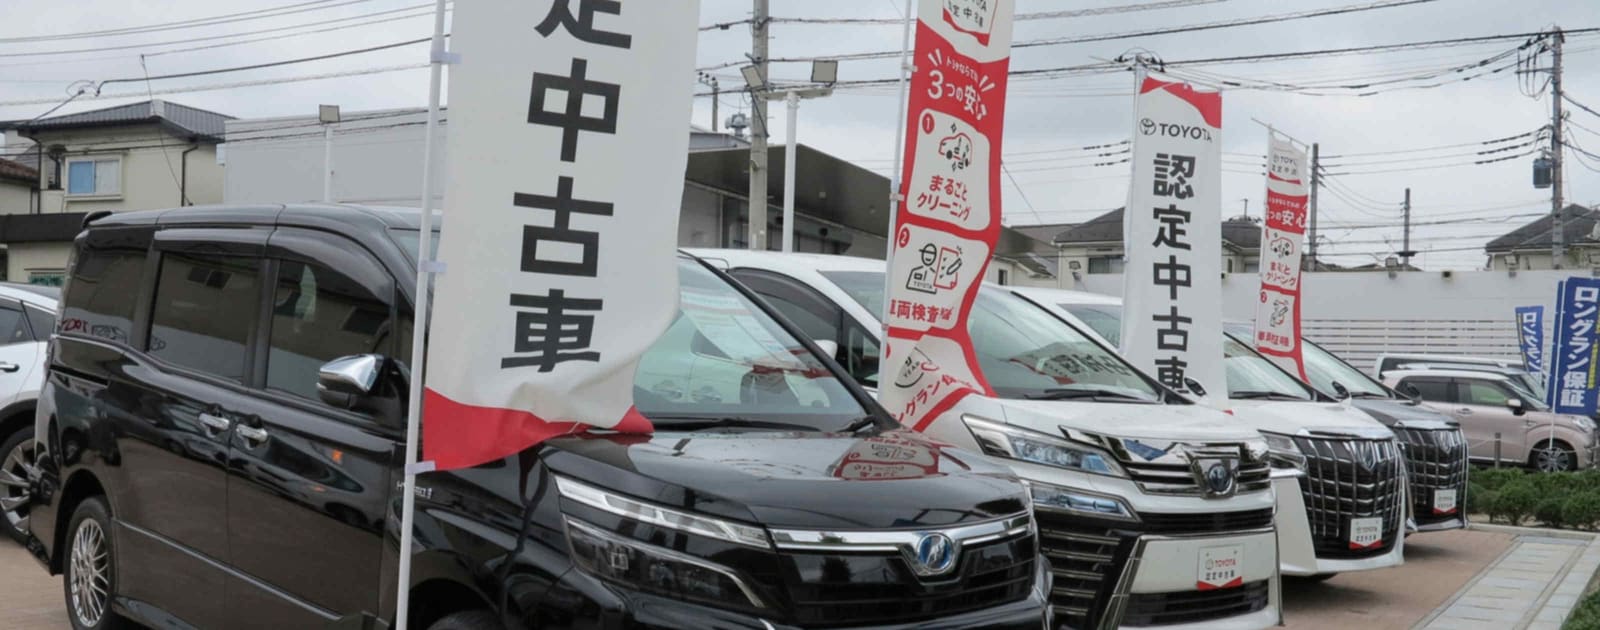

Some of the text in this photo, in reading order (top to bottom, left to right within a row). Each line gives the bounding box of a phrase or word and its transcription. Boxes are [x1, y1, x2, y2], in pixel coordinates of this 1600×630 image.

[1159, 122, 1212, 142] TOYOTA
[1152, 152, 1196, 394] 認定中古車
[1559, 286, 1599, 408] ロングラン保証
[1215, 558, 1237, 567] TOYOTA
